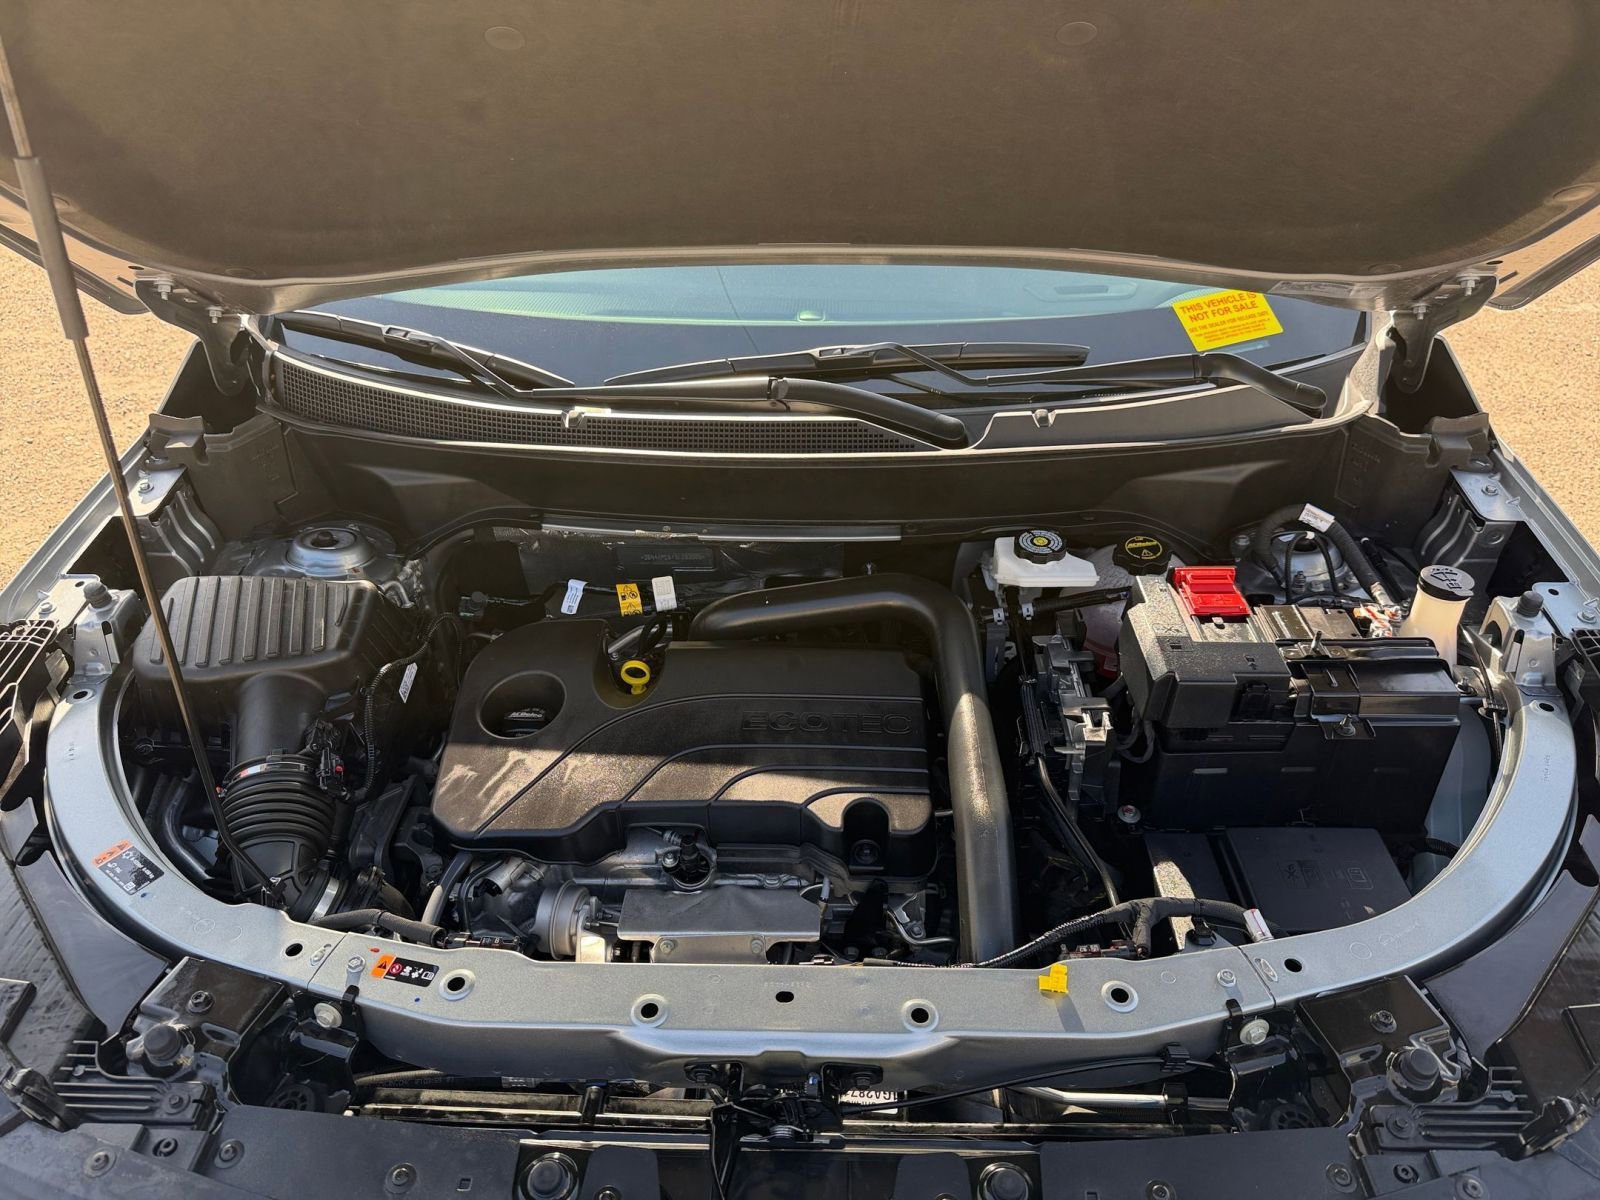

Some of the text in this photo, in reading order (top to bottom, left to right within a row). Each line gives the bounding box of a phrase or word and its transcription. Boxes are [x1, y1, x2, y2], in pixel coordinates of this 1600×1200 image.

[1179, 290, 1257, 314] THIS VEHICLE IS
[1189, 300, 1258, 322] NOT FOR SALE
[741, 710, 912, 734] ECOTEC
